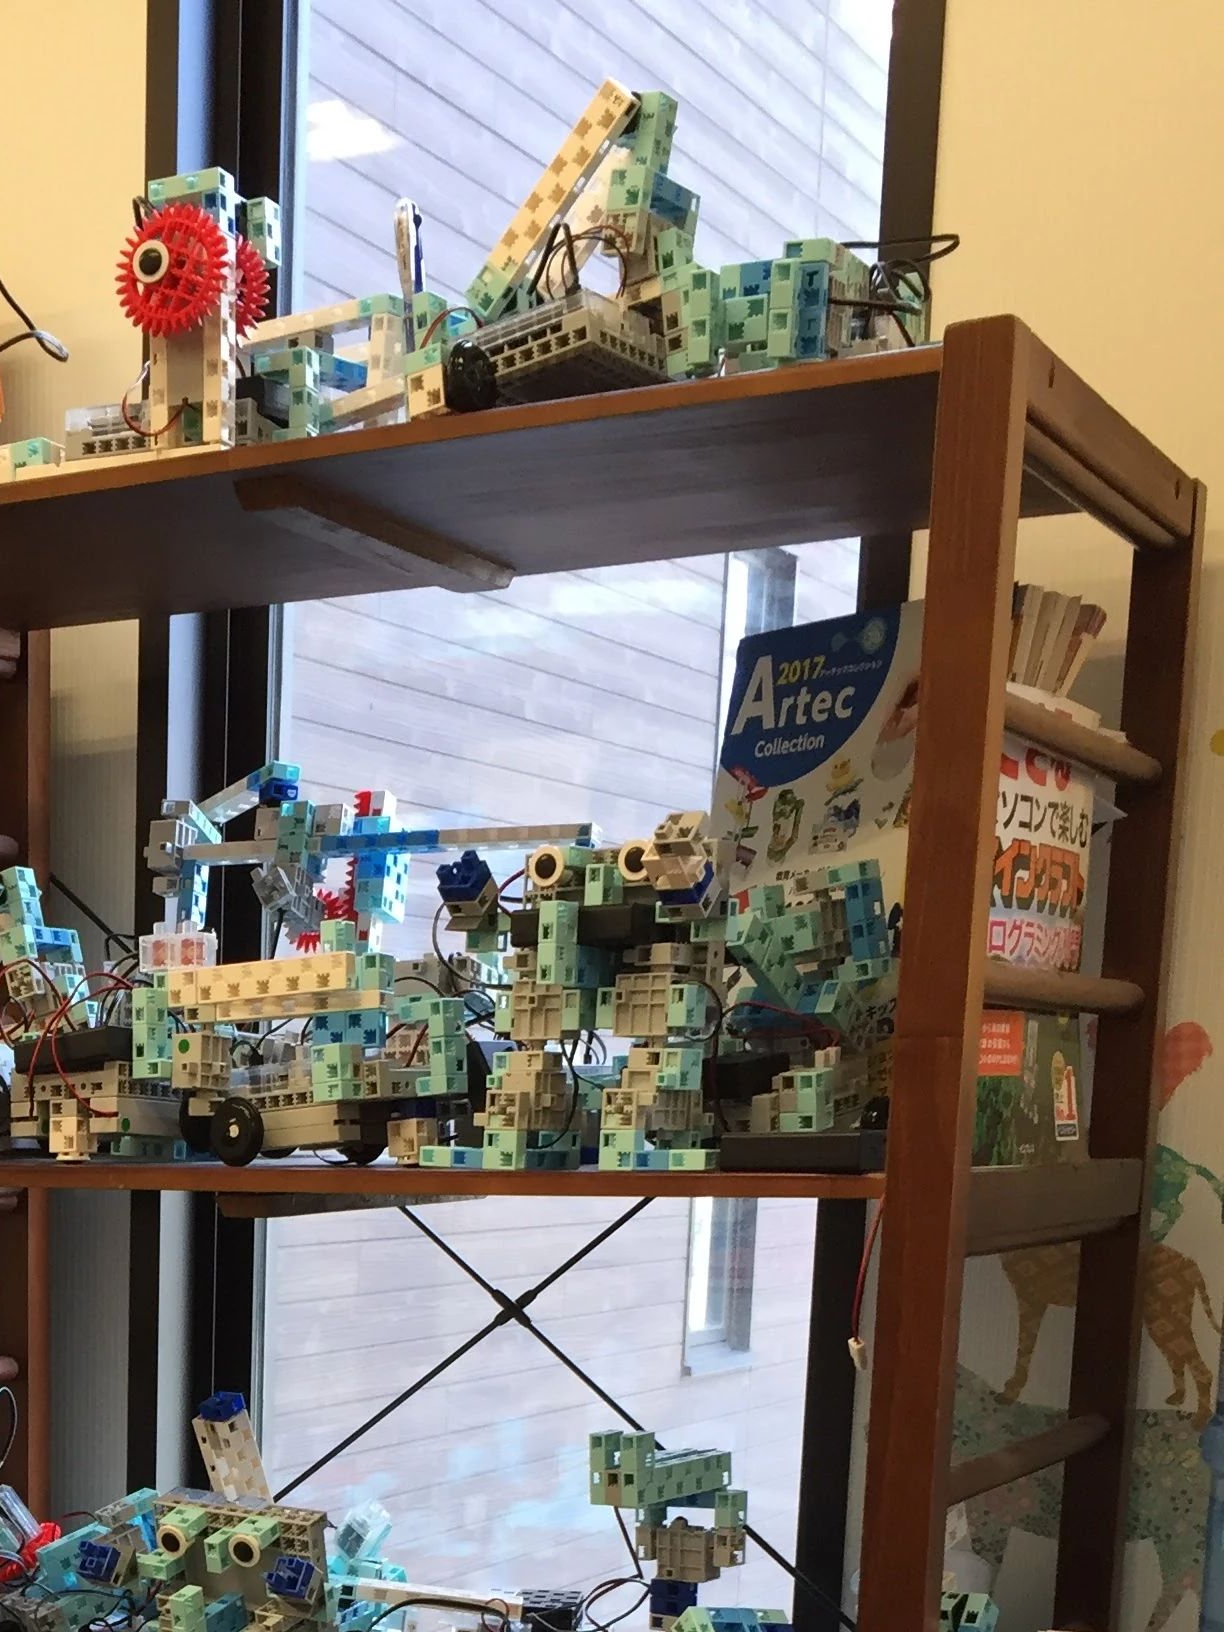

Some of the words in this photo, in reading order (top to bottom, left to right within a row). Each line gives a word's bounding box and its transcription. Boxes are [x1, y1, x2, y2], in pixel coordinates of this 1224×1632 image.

[731, 655, 856, 736] Artec
[775, 655, 827, 686] 2017
[754, 733, 825, 758] Collection
[998, 789, 1089, 848] ソコンで楽しむ
[993, 838, 1085, 917] インクラフト
